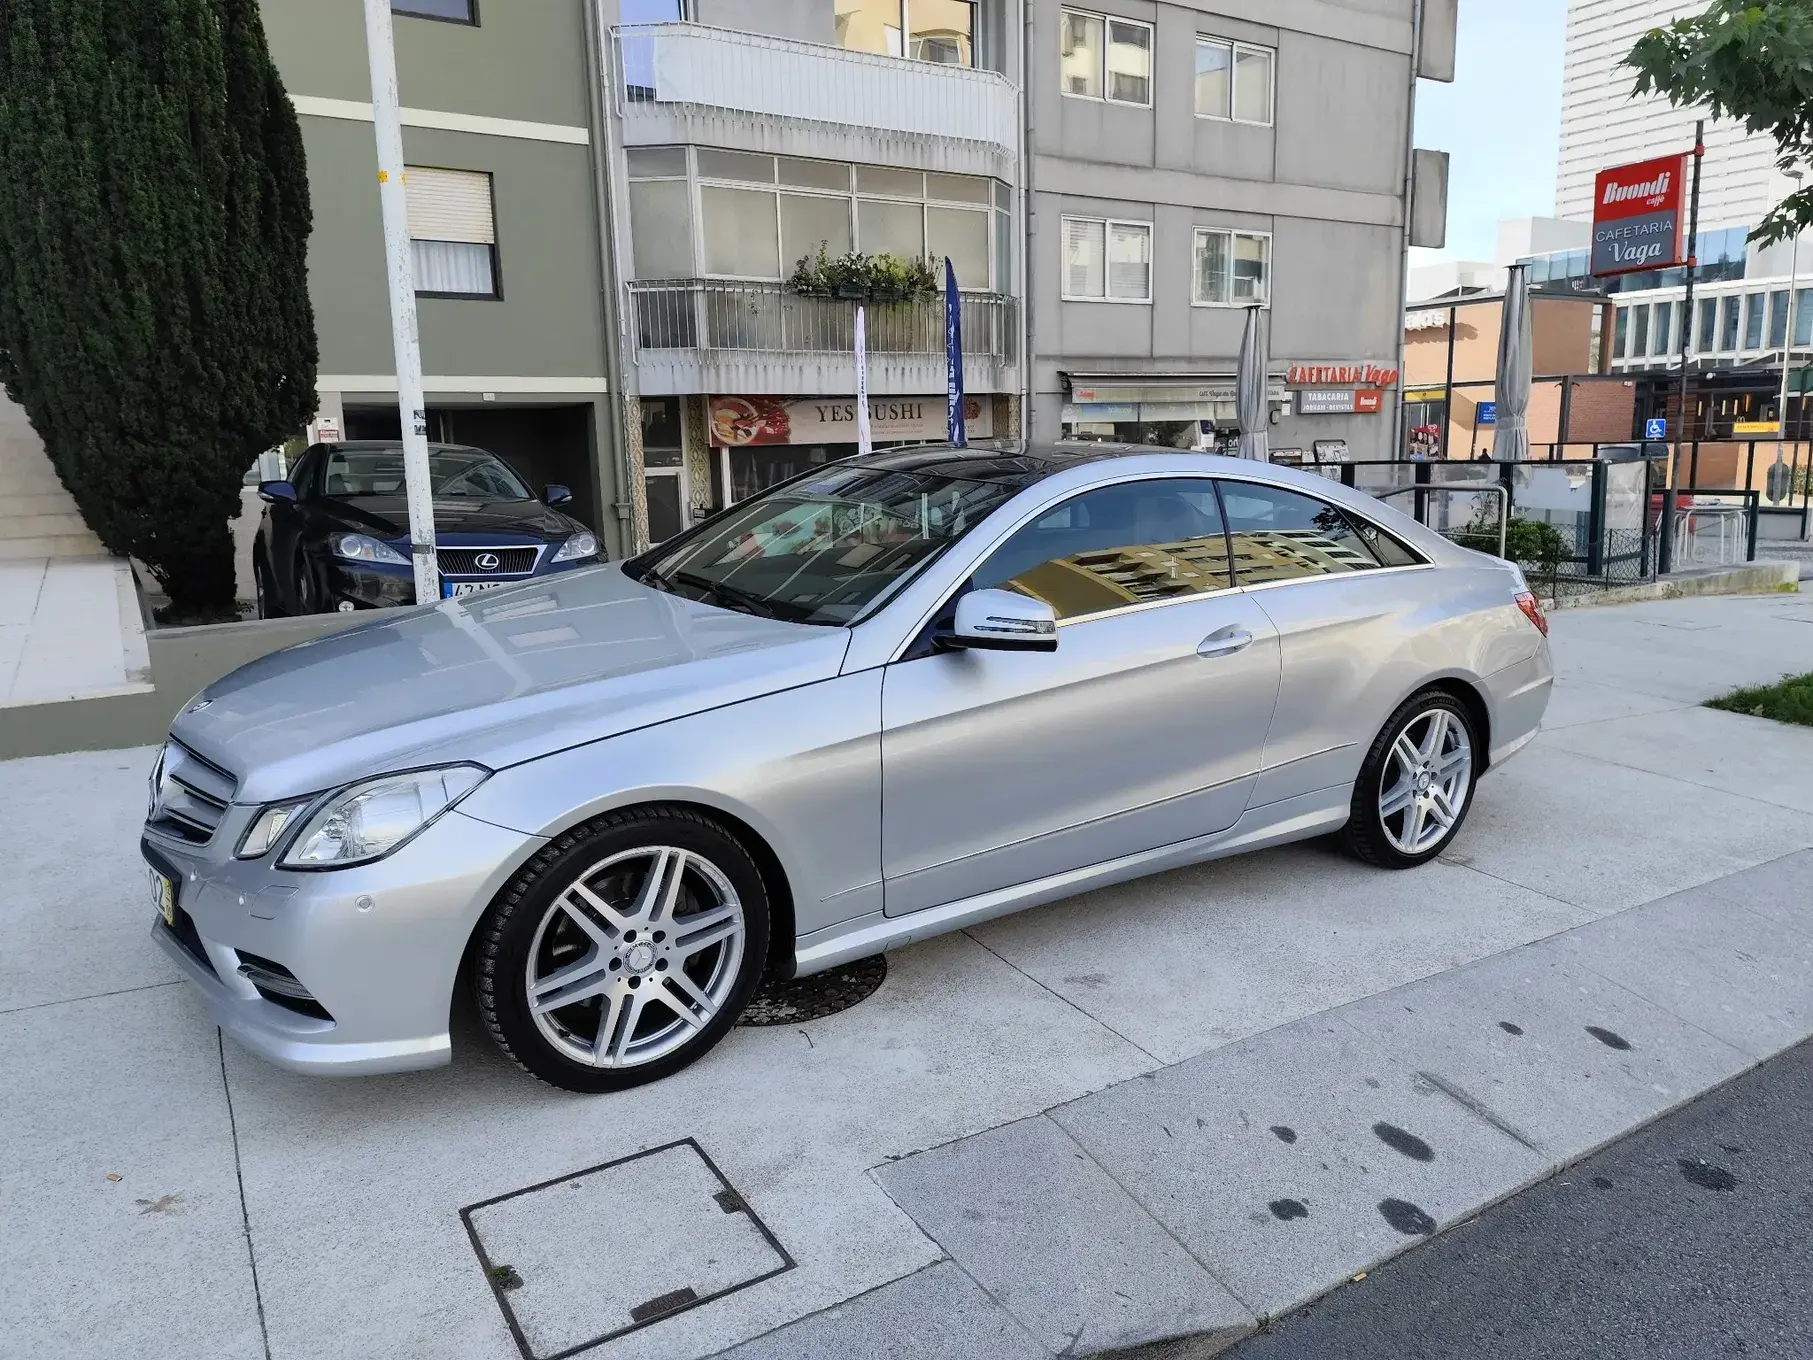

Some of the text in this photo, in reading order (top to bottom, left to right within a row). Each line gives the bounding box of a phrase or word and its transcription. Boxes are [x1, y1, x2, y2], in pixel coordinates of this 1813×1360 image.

[1602, 172, 1671, 204] Buondi
[1596, 221, 1672, 242] CAFETARIA
[1608, 241, 1662, 265] Vaga
[1288, 366, 1361, 383] CAFETARIA
[1308, 392, 1349, 401] TABACARIA
[814, 404, 854, 422] YES
